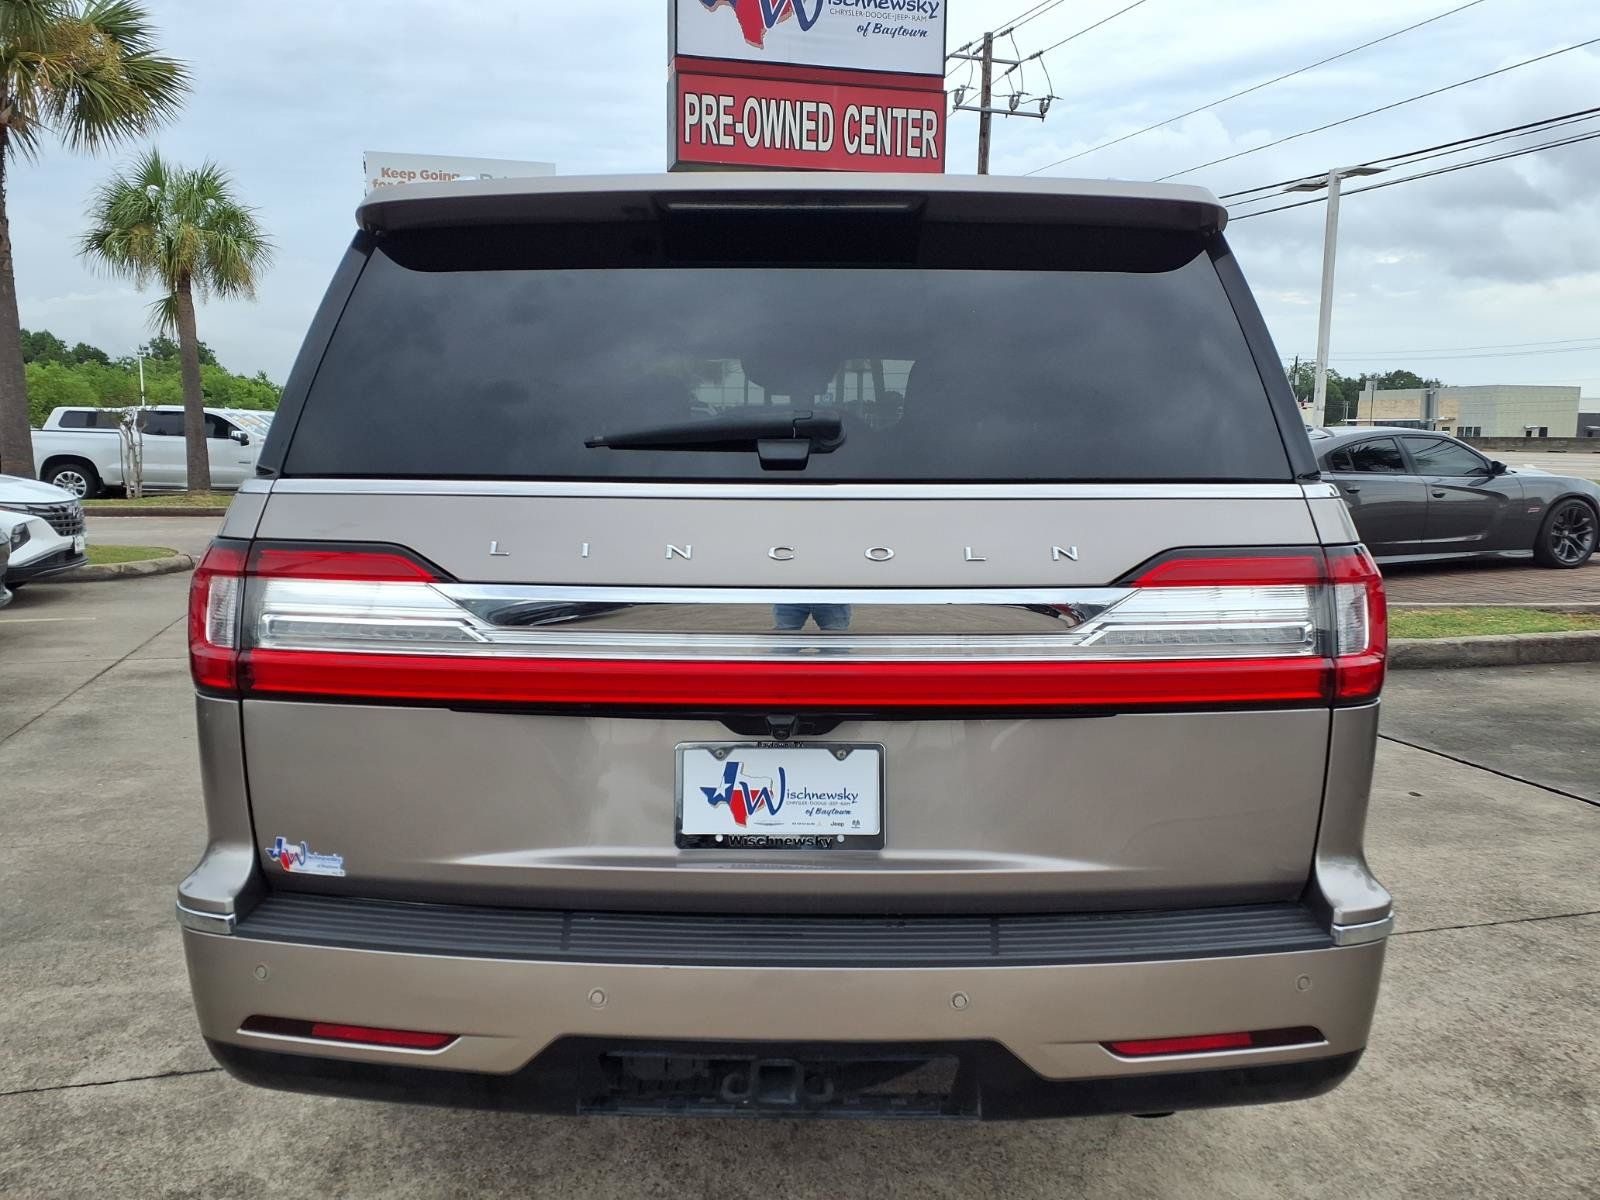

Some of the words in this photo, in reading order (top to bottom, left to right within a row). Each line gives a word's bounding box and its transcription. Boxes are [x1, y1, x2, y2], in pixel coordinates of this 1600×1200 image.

[856, 22, 871, 37] of
[872, 23, 928, 38] Baytown
[684, 92, 834, 152] PRE-OWNED
[843, 104, 938, 159] CENTER
[381, 167, 417, 181] Keep
[489, 540, 1079, 562] LINCOLN
[815, 808, 851, 816] Baytown
[729, 835, 833, 848] Wischnewsky
